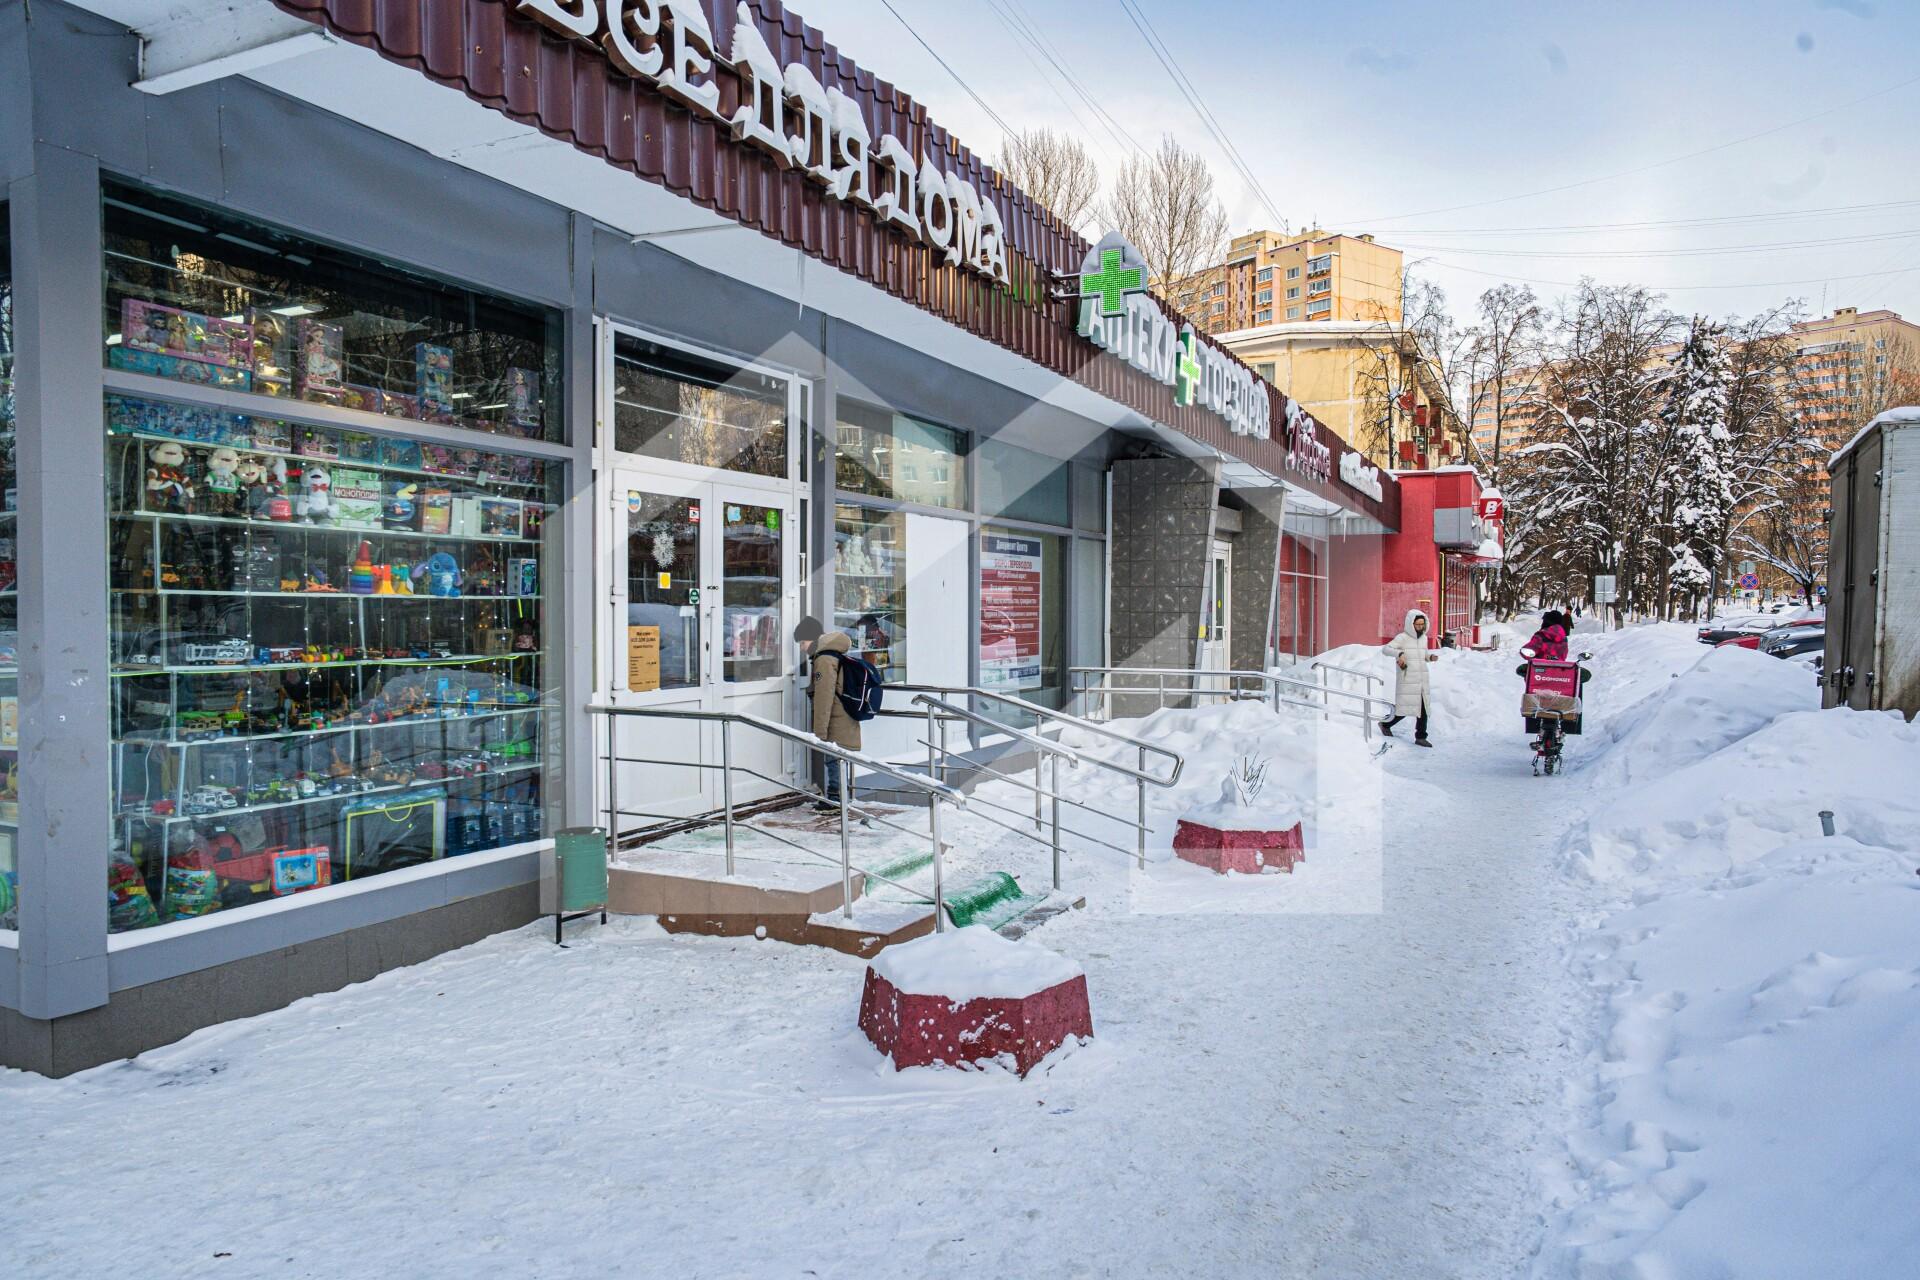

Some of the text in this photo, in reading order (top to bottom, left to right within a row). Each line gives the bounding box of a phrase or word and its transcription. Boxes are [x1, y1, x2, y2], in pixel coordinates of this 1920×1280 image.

[732, 52, 873, 206] ДЛЯ
[876, 145, 1010, 286] ДОМА
[1199, 348, 1271, 441] ГОРЗДРАВ
[334, 487, 379, 501] МОНОПОЛИЯ
